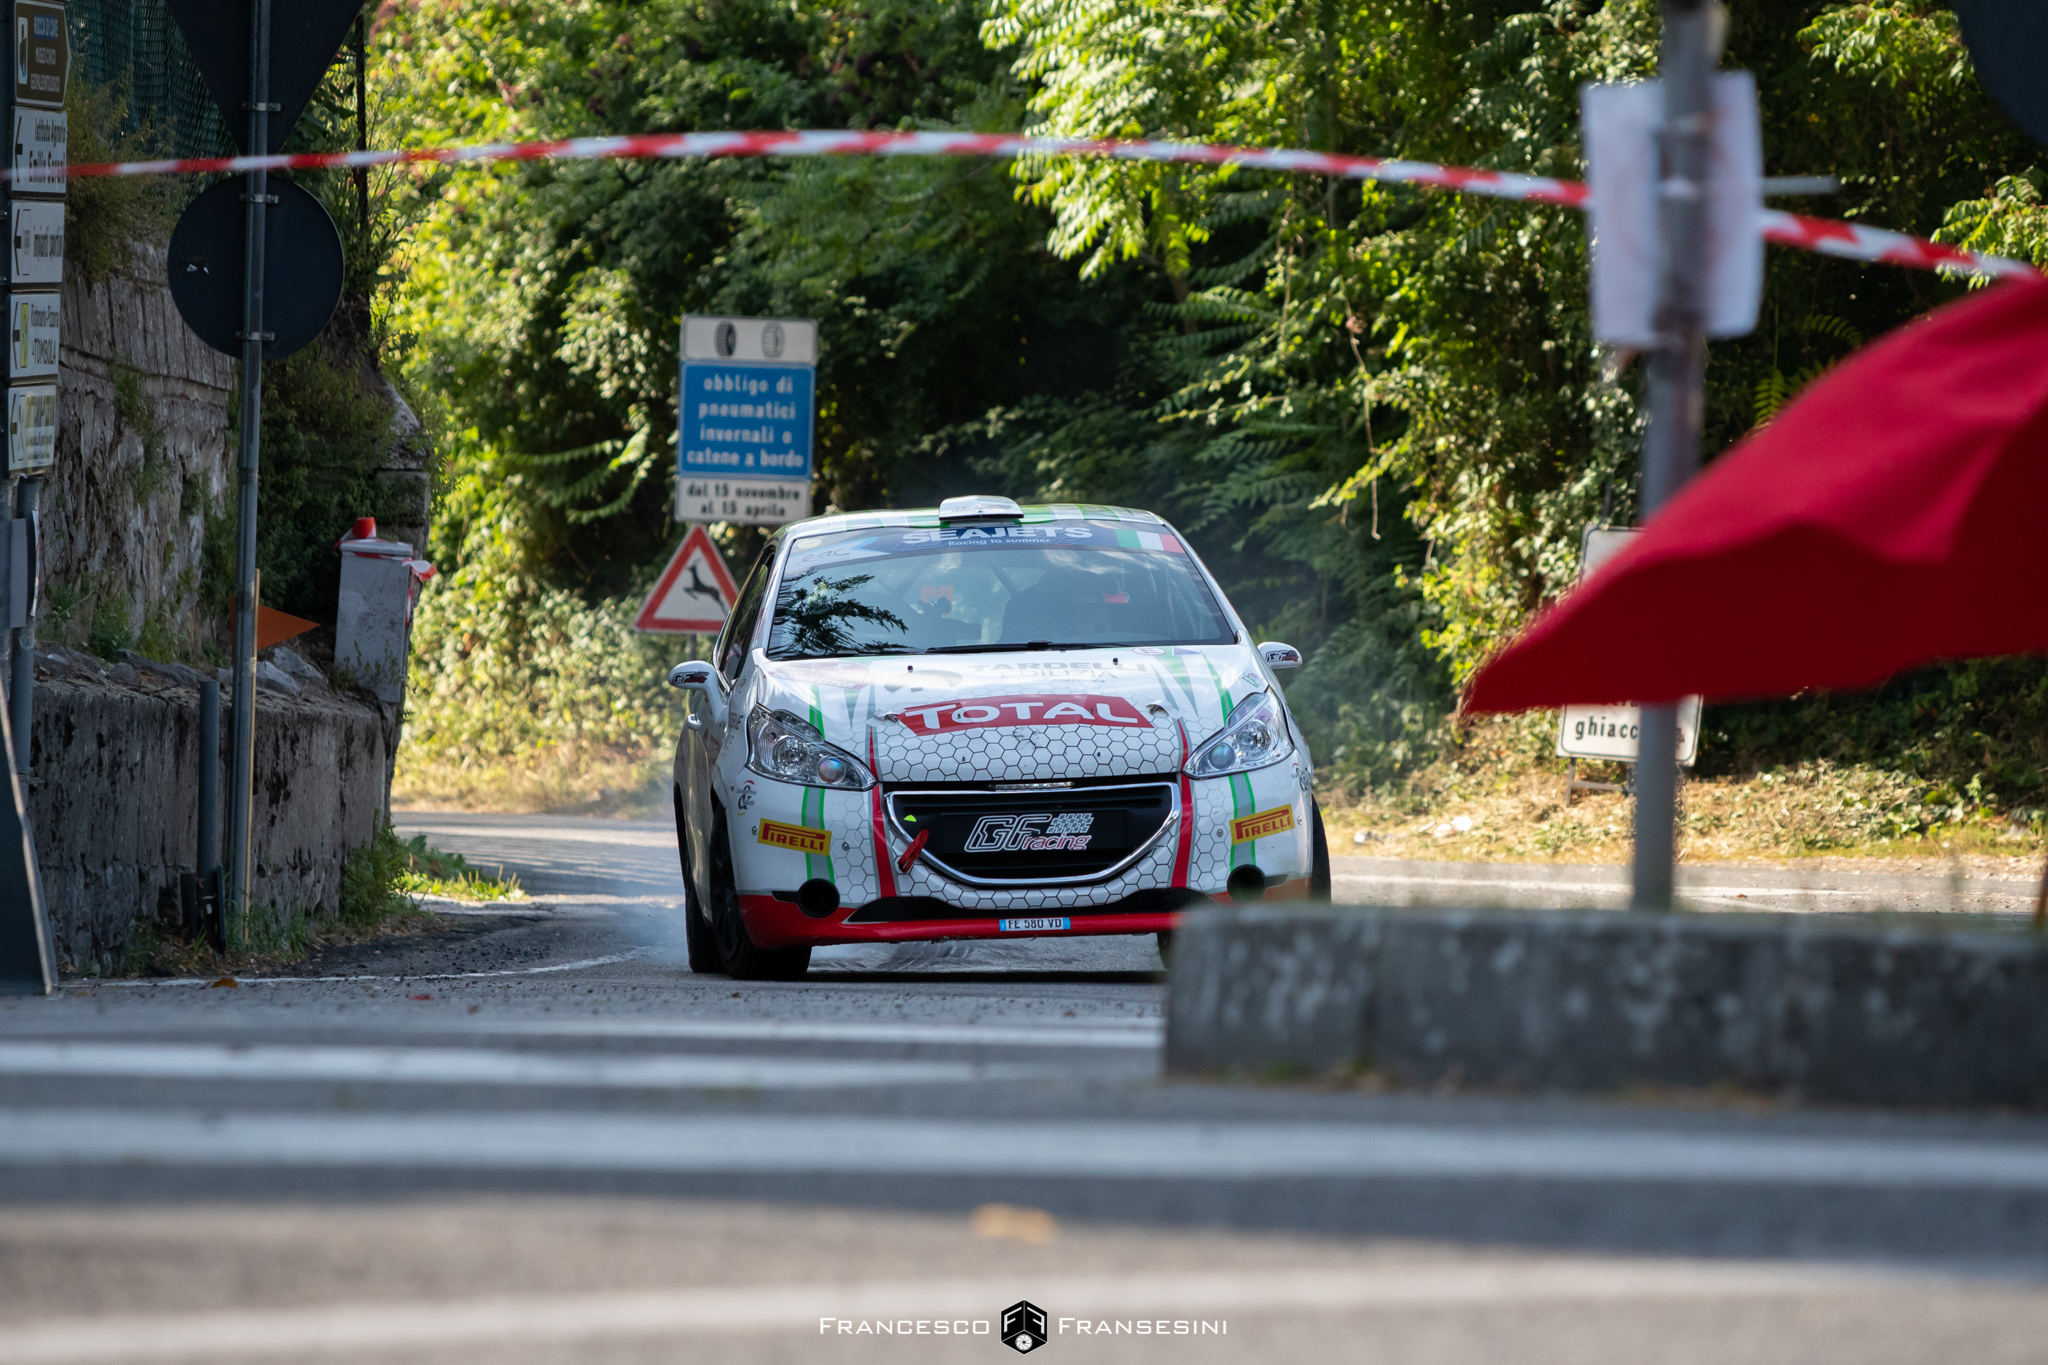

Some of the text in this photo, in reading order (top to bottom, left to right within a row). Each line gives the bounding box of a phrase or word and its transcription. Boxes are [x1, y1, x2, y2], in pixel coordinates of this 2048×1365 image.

[703, 374, 793, 397] obbligo di
[698, 401, 796, 420] pneumatici
[700, 423, 792, 444] invernali o
[686, 447, 804, 468] catene a bordo
[688, 483, 800, 500] dal 15 novembre
[701, 501, 785, 519] al 15 aprile
[902, 526, 1093, 545] SEAJETS
[948, 538, 987, 547] Racing
[966, 662, 1147, 672] TARDELLI
[1000, 670, 1118, 679] EDILIZIA
[904, 702, 1138, 729] TOTAL
[1575, 716, 1639, 740] ghiacc
[964, 814, 1053, 852] GF
[1235, 808, 1291, 840] PIRELLI
[762, 822, 826, 851] PIRELLI
[1022, 832, 1092, 851] racing
[1008, 918, 1062, 930] FE 580 VD
